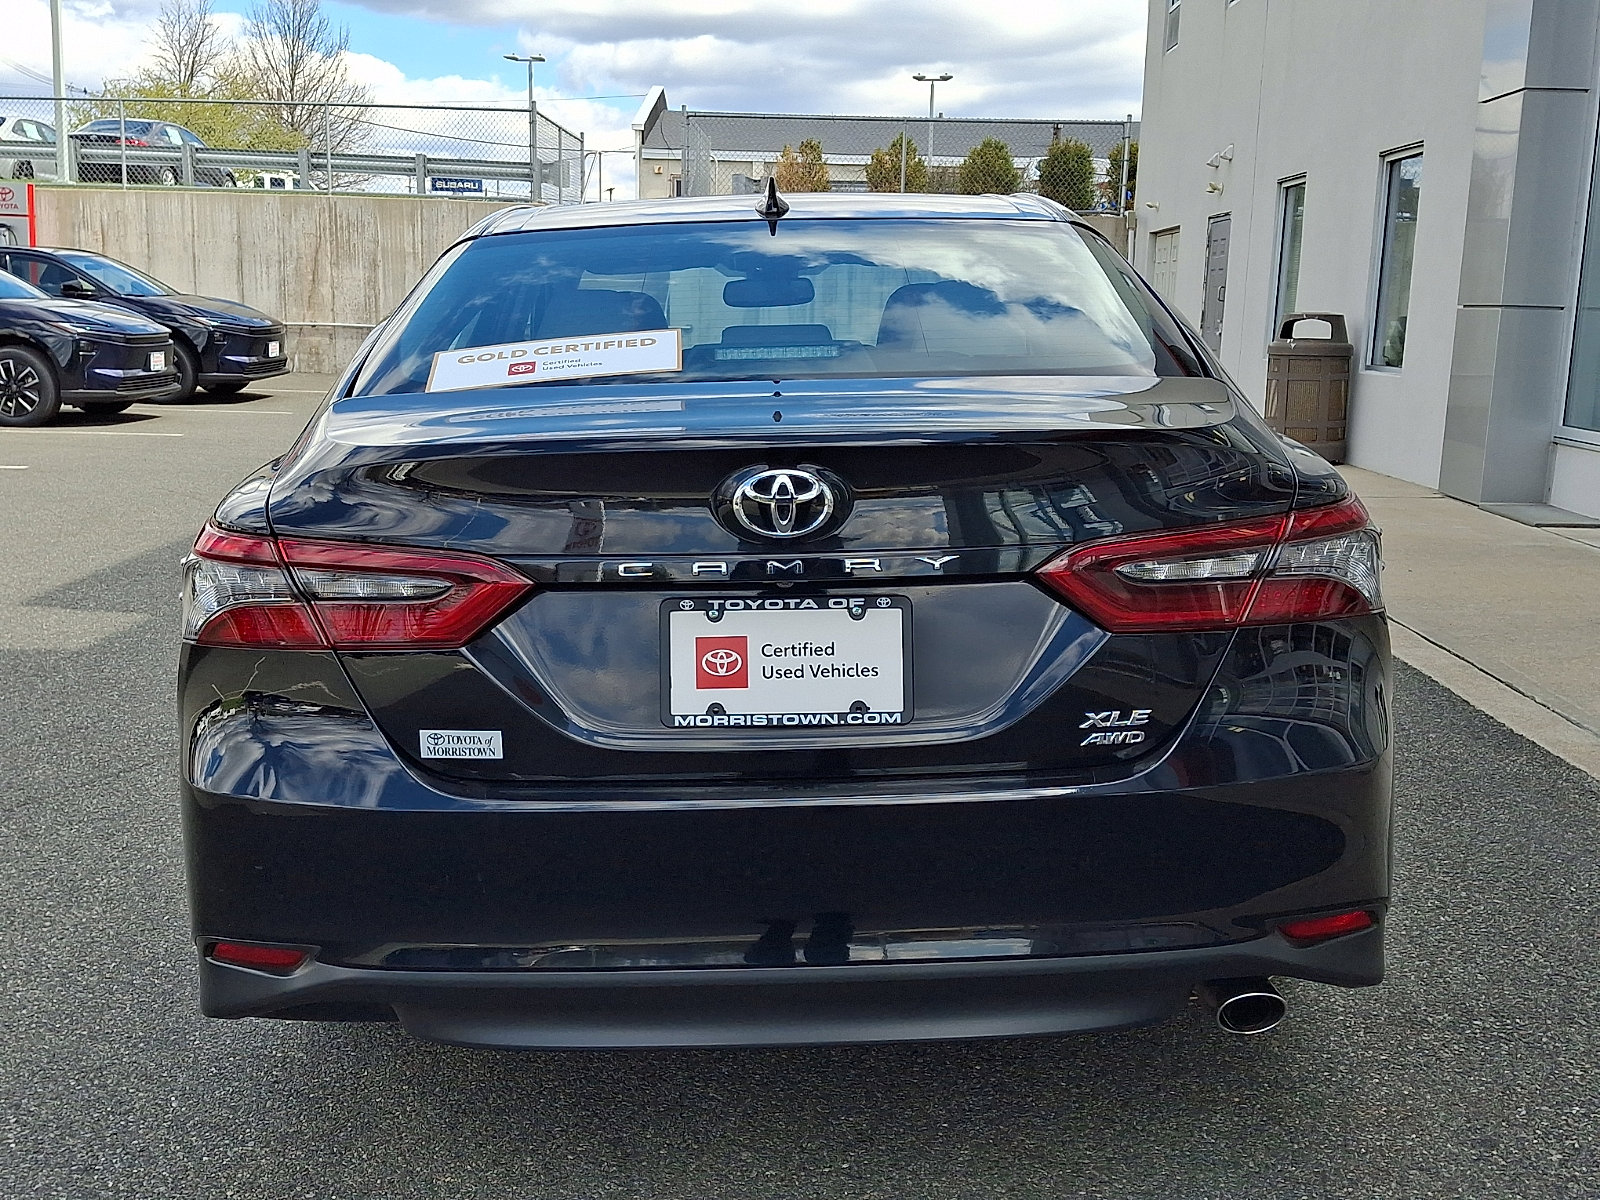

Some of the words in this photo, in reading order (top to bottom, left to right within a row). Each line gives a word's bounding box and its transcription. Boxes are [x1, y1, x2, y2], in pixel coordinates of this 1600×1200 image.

[436, 181, 478, 189] SUBARU
[457, 349, 528, 364] GOLD
[533, 338, 657, 356] CERTIFIED
[542, 358, 581, 366] Certified
[542, 363, 565, 371] Used
[567, 360, 603, 369] Vehicles
[618, 554, 960, 577] CAMRY
[707, 598, 819, 610] TOYOTA
[828, 597, 866, 609] OF
[761, 641, 835, 658] Certified
[762, 664, 805, 679] Used
[809, 663, 879, 679] Vehicles
[674, 712, 901, 727] MORRISTOWN.COM
[1079, 709, 1153, 729] XLE
[444, 734, 483, 745] TOYOTA
[484, 736, 494, 748] of
[1080, 730, 1145, 747] AWD
[426, 746, 496, 757] MORRISTOWN
